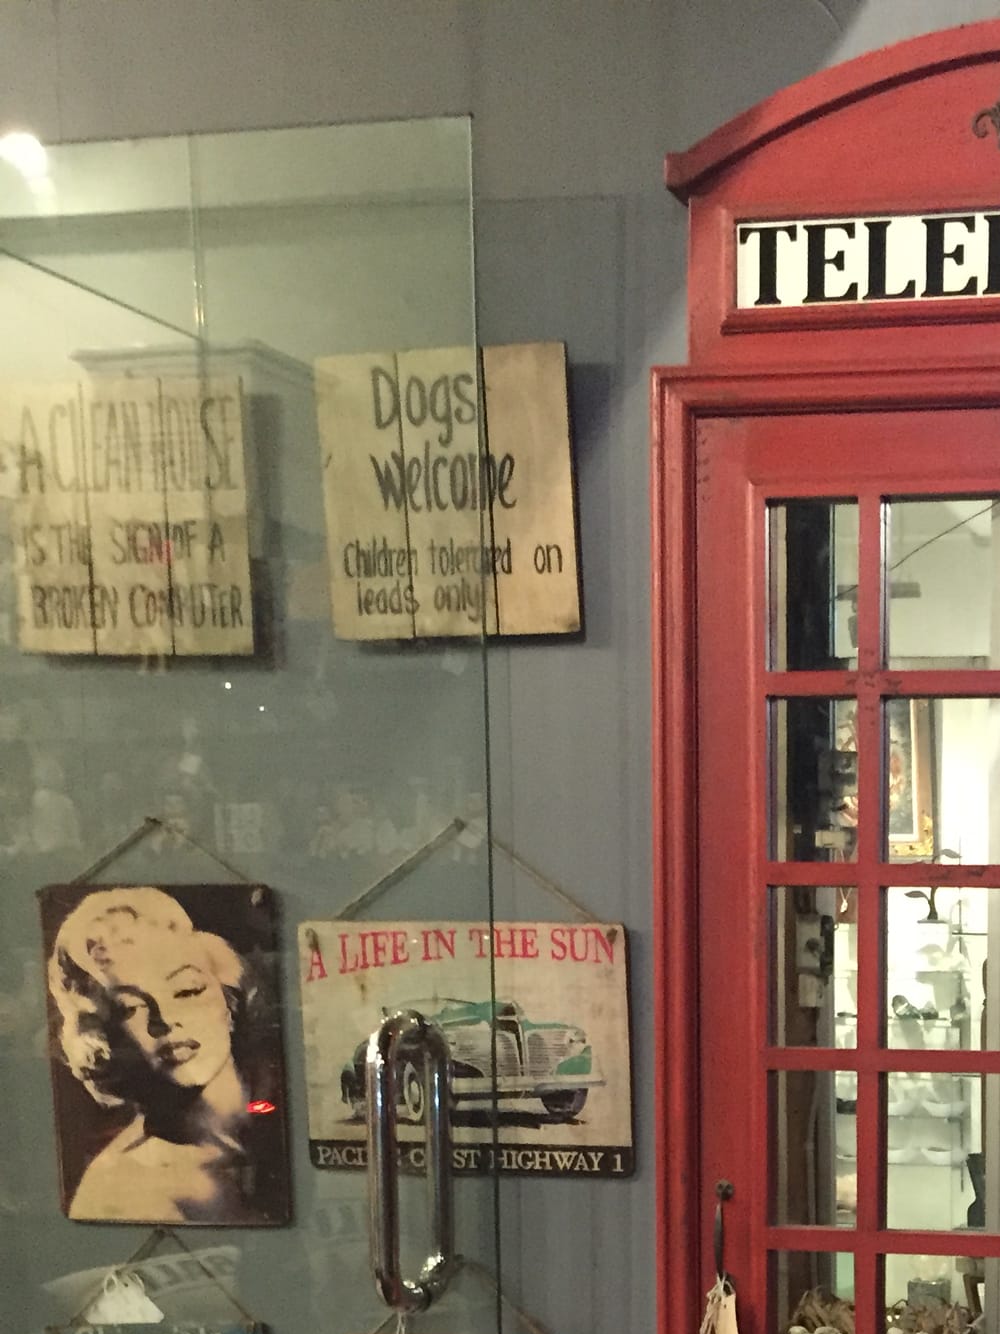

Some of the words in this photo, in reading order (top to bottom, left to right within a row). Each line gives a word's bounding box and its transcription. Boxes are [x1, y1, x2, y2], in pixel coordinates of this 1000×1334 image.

[371, 366, 477, 447] Dogs
[17, 404, 46, 495] A
[49, 399, 143, 493] CLEAN
[22, 523, 46, 566] IS
[110, 517, 165, 565] SIGN
[171, 520, 197, 561] OF
[208, 522, 226, 563] A
[343, 537, 419, 578] Children
[533, 543, 563, 575] on
[31, 583, 119, 630] BROKEN
[357, 581, 420, 617] leads
[434, 577, 481, 623] only
[305, 945, 328, 983] A
[338, 931, 410, 975] LIFE
[421, 929, 457, 961] IN
[468, 928, 538, 959] THE
[551, 928, 616, 964] SUN
[410, 1149, 480, 1169] CST
[489, 1149, 603, 1172] HIGHWAY
[612, 1153, 624, 1172] 1
